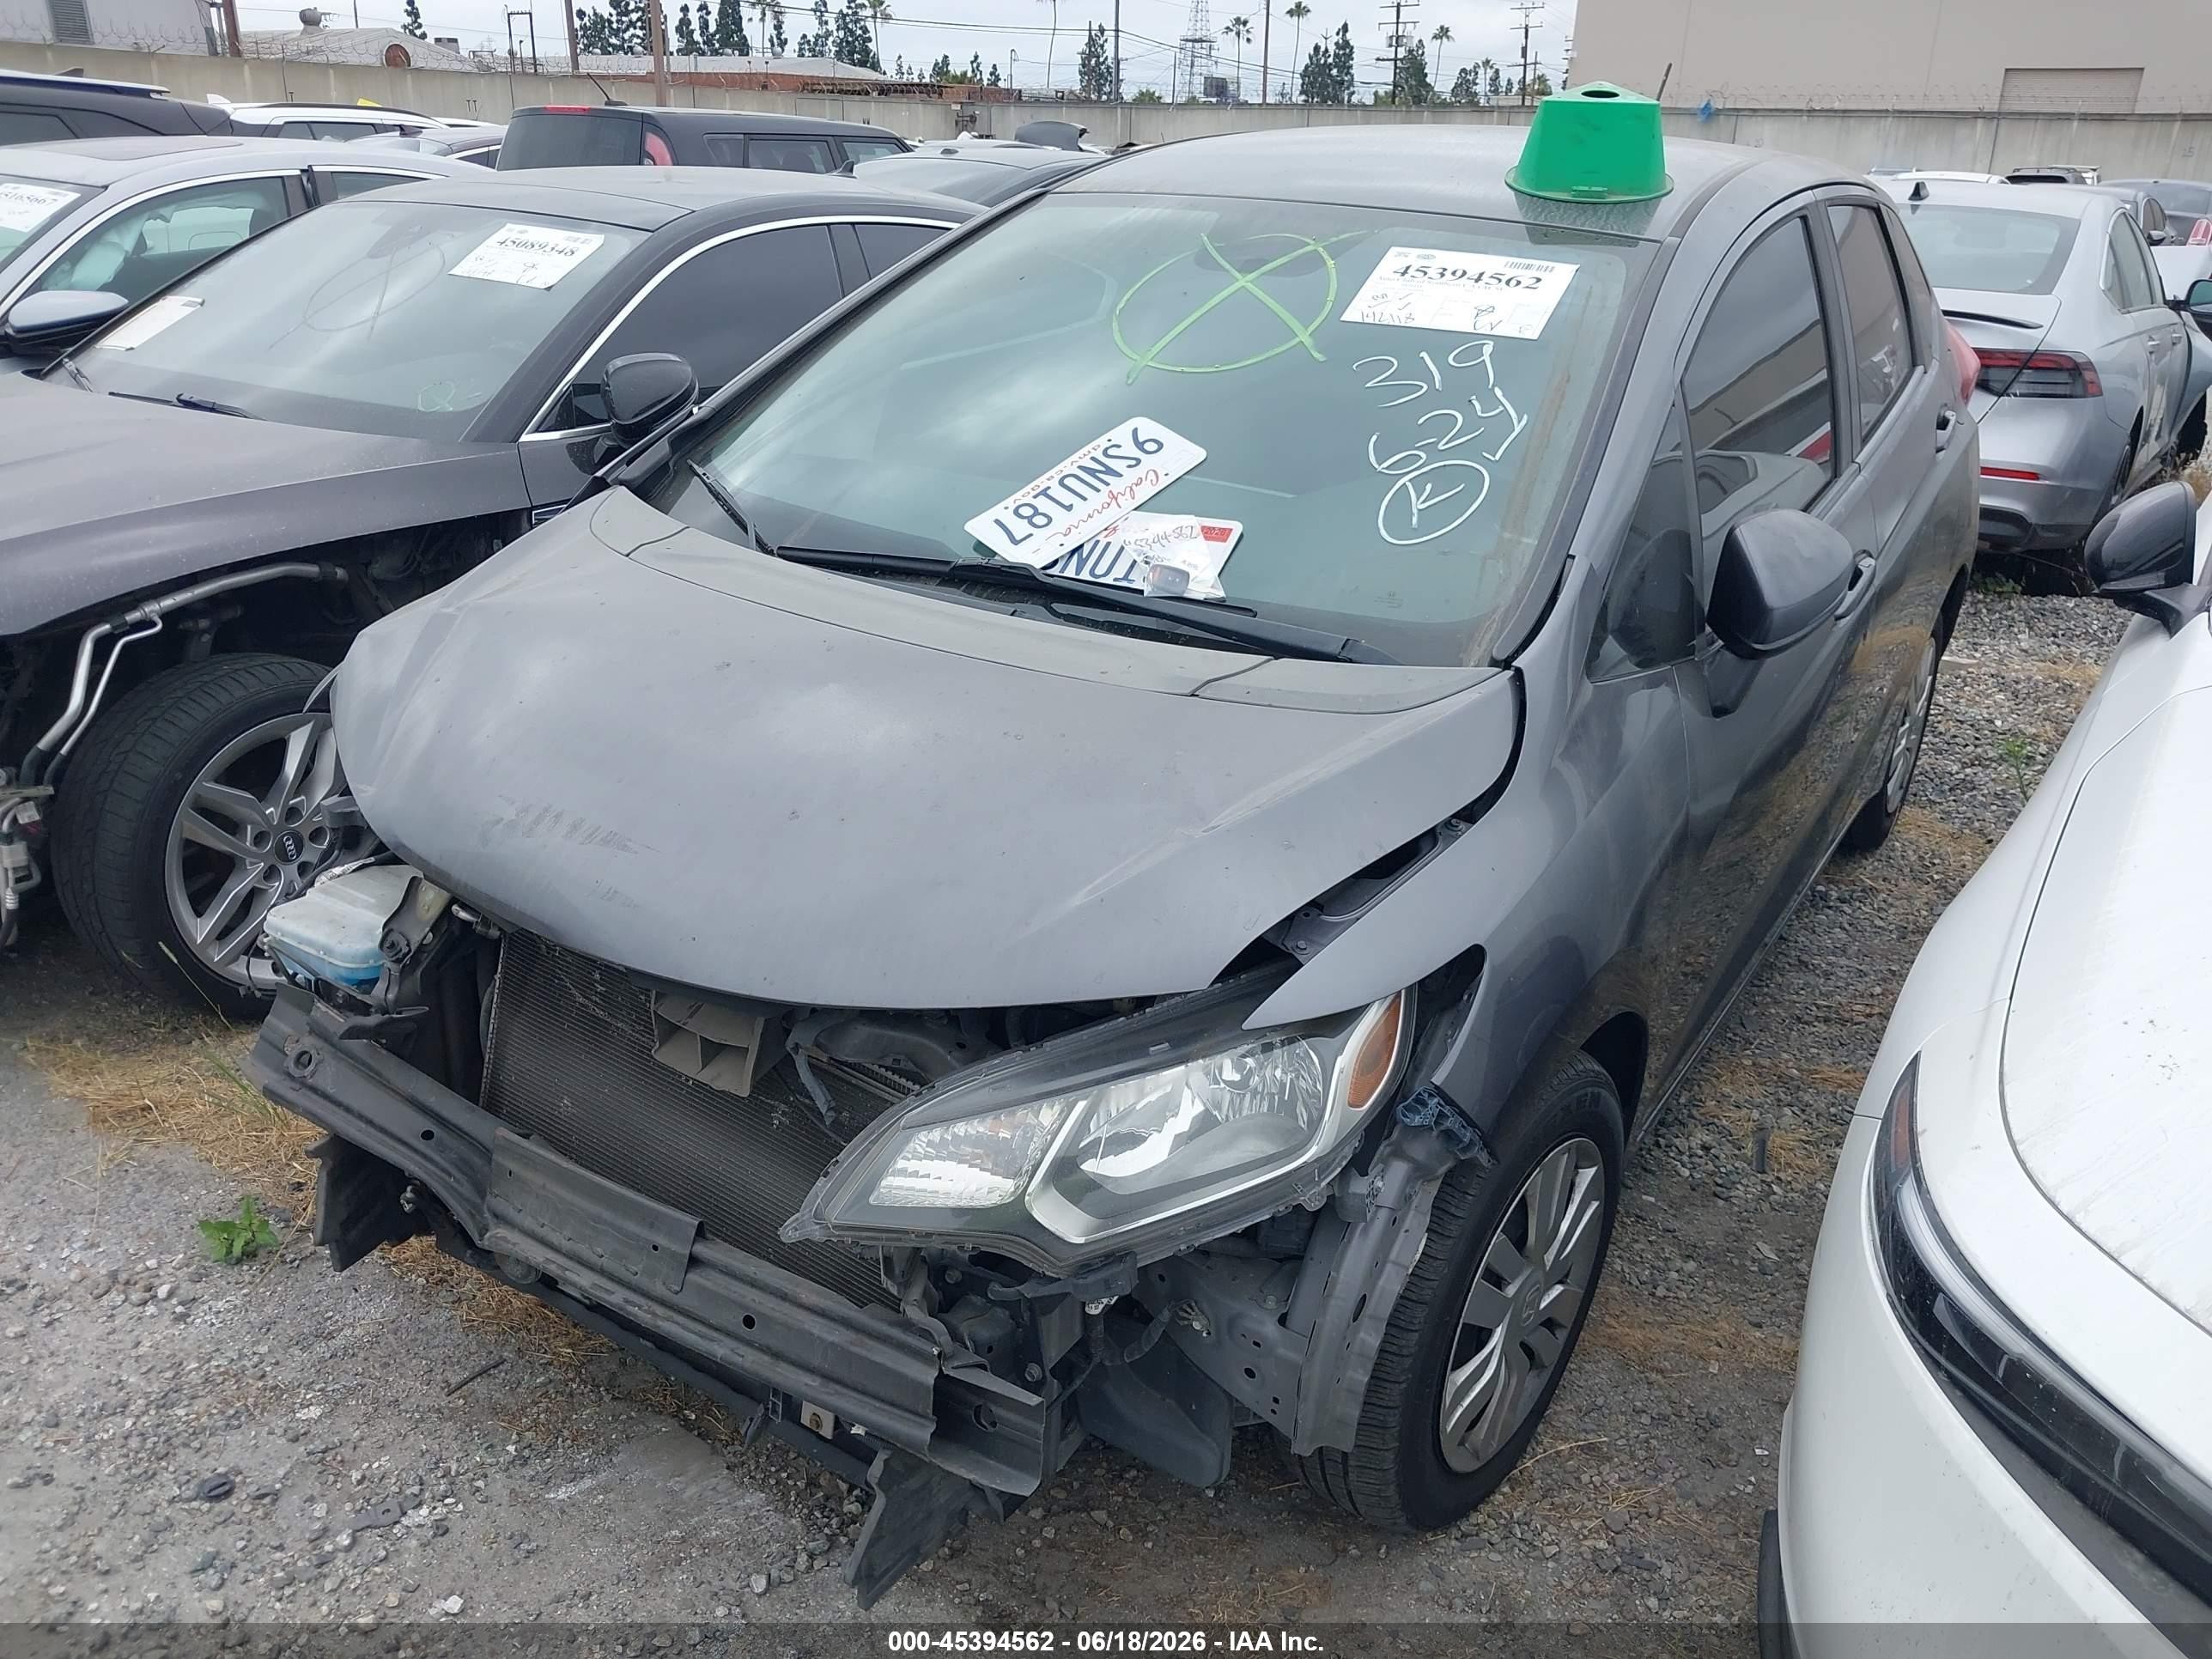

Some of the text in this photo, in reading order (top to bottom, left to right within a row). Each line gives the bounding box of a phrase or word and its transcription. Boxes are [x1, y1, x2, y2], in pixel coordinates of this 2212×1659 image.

[1393, 264, 1543, 291] 45394562
[1352, 340, 1494, 408] 319
[994, 427, 1164, 545] 9SNU187
[1044, 468, 1159, 541] California
